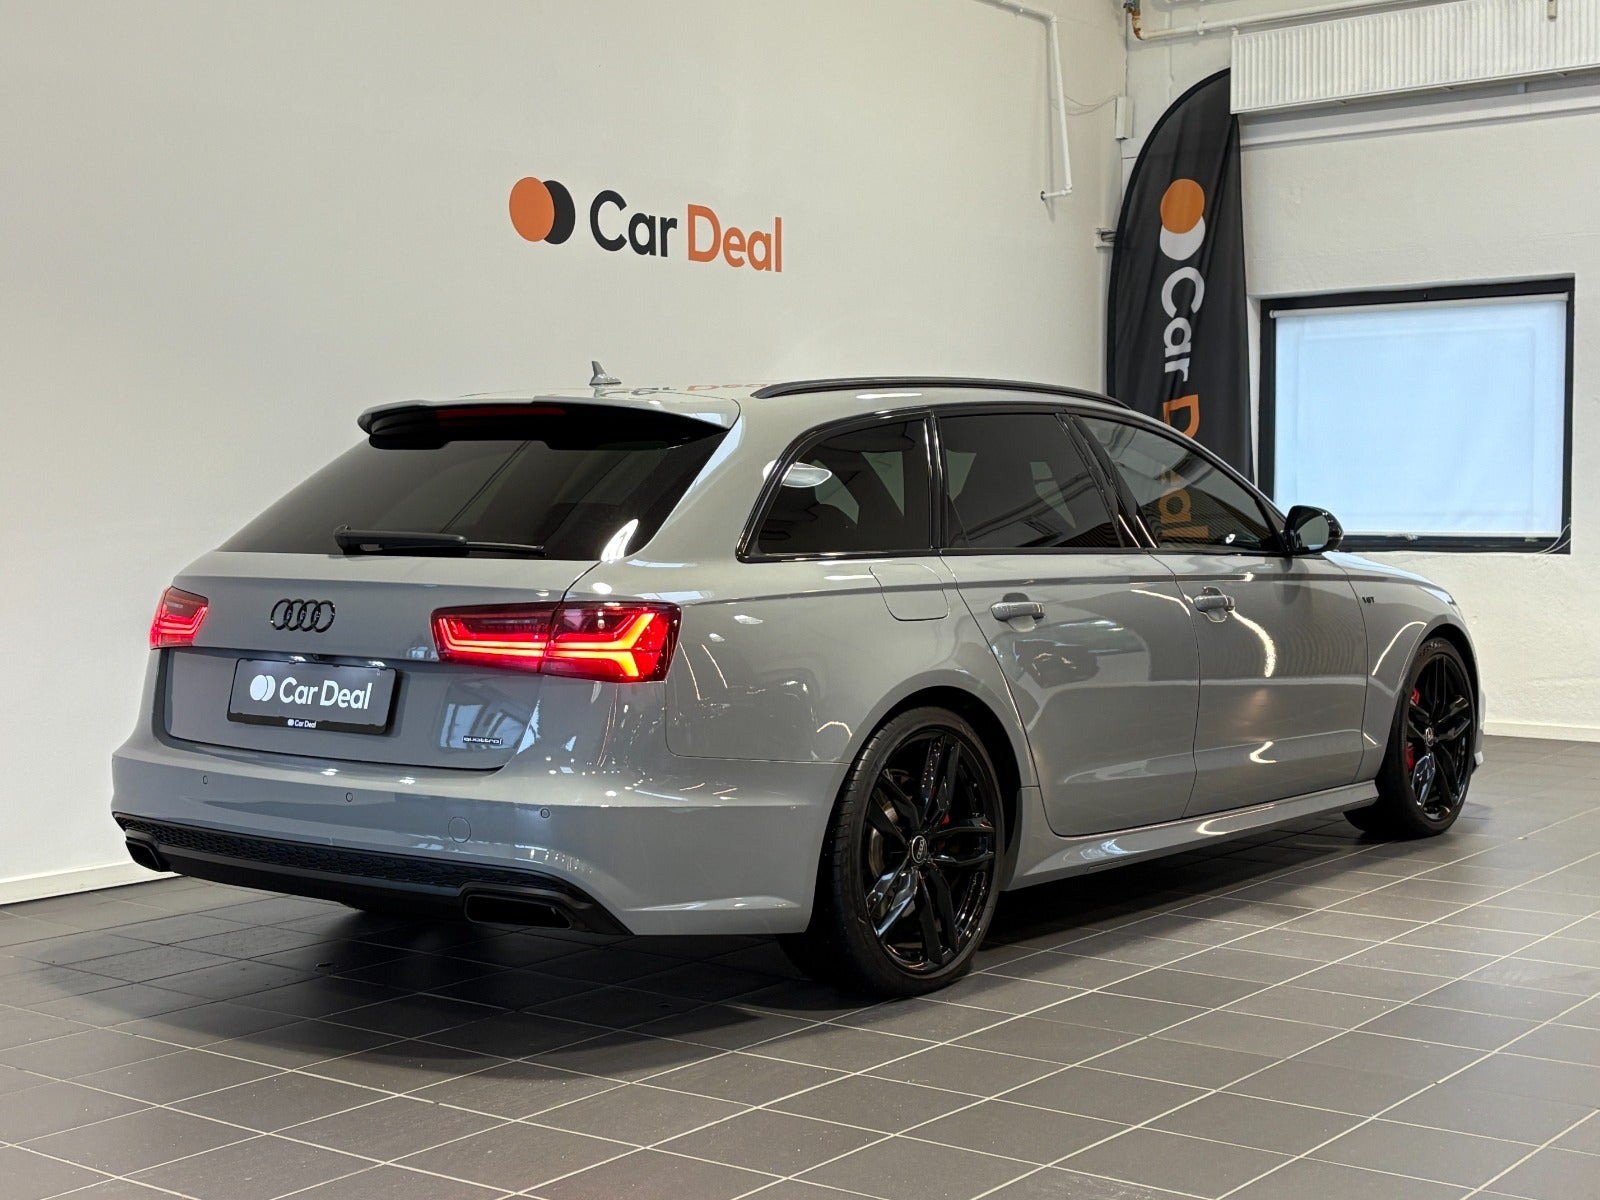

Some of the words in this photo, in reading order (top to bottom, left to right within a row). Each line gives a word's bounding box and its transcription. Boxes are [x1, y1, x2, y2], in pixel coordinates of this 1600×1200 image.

[590, 190, 678, 257] Car
[687, 203, 782, 272] Deal
[1161, 266, 1205, 382] Car
[279, 676, 319, 704] Car
[320, 680, 373, 710] Deal
[294, 719, 305, 727] Car
[304, 720, 317, 729] Deal
[463, 736, 500, 744] quattro
